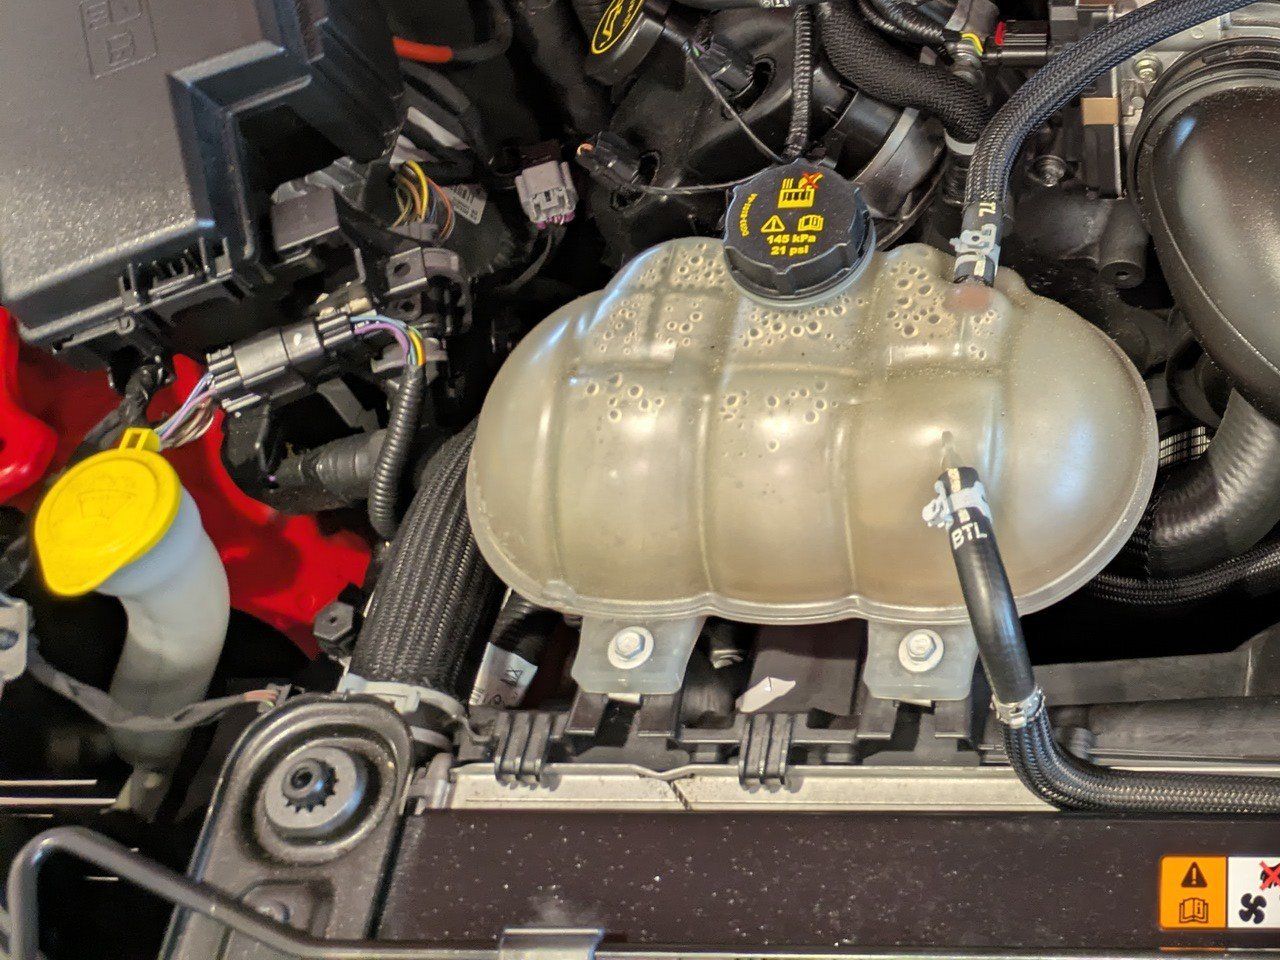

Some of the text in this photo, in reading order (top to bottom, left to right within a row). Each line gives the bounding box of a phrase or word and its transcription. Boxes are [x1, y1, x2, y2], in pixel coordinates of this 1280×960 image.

[766, 233, 817, 244] 145 kPa
[771, 244, 809, 257] 21 psi
[951, 521, 988, 550] BTL
